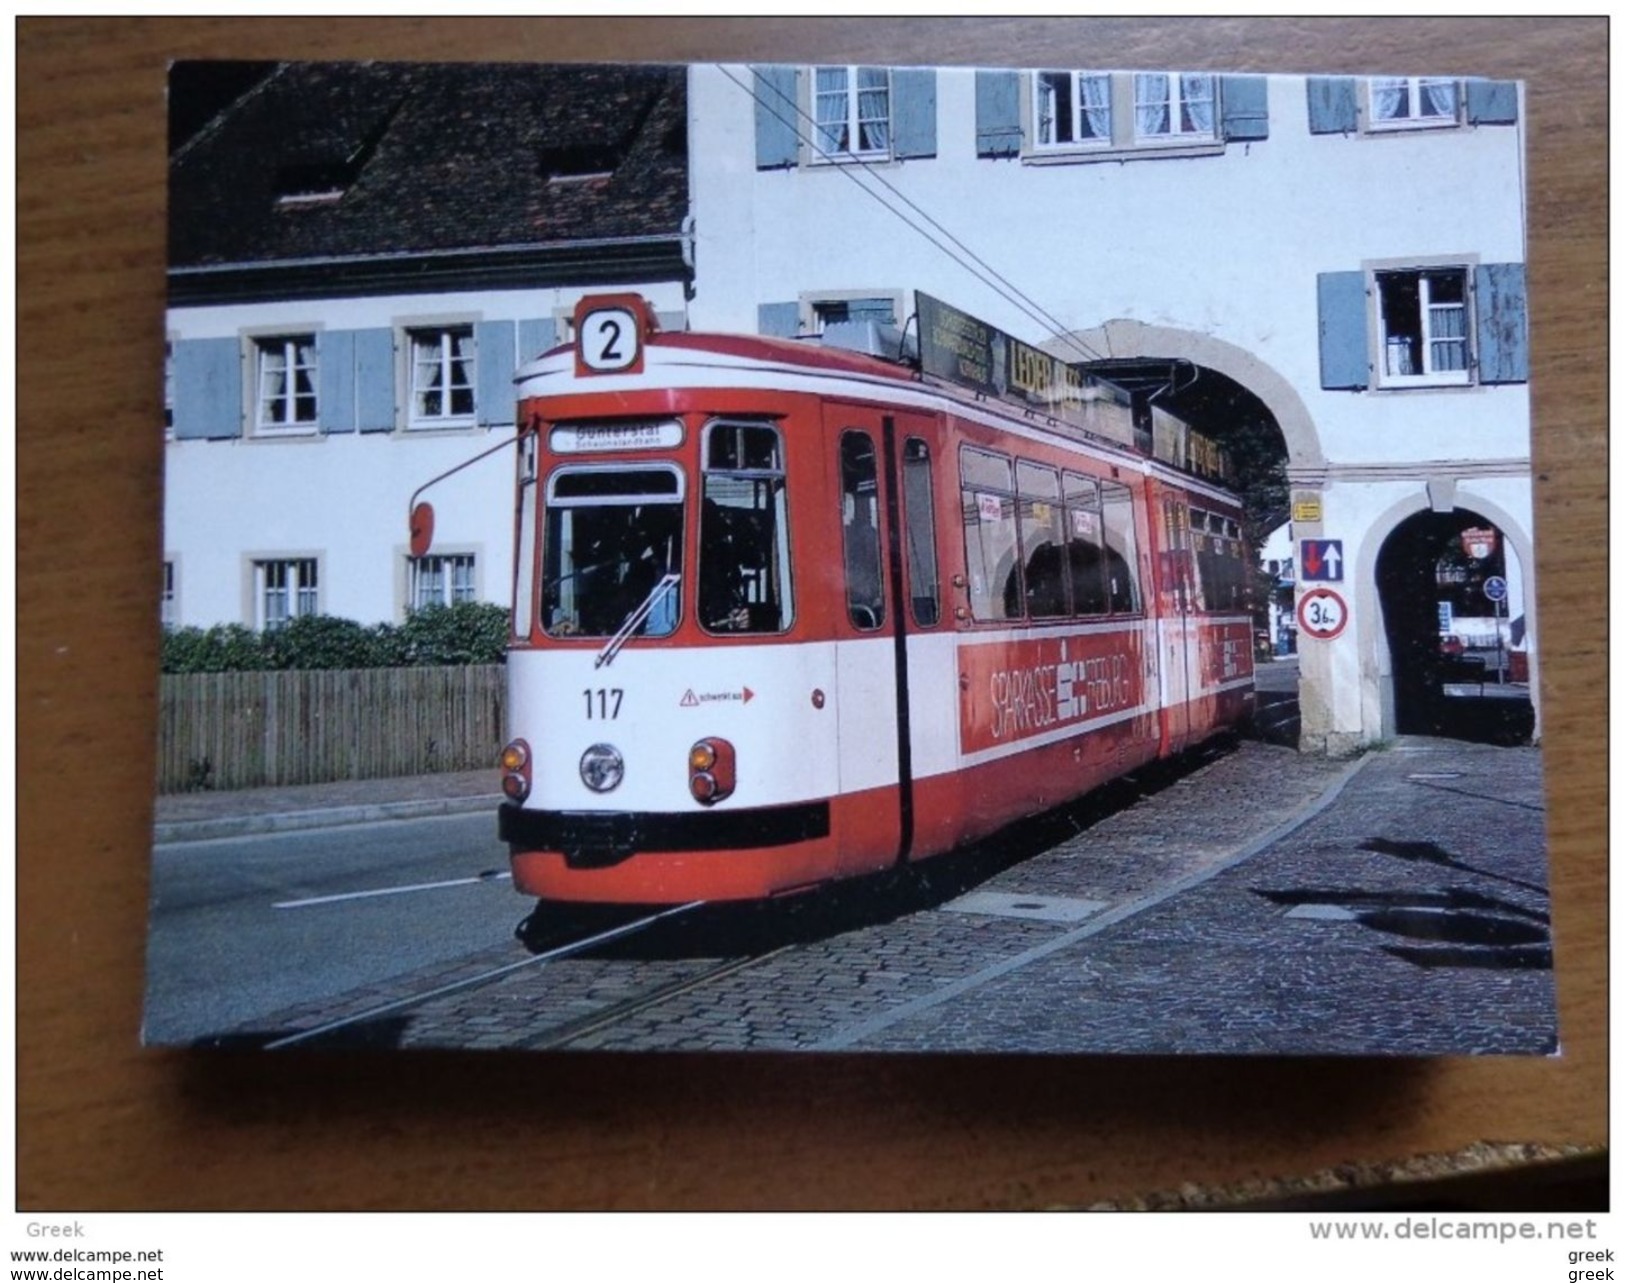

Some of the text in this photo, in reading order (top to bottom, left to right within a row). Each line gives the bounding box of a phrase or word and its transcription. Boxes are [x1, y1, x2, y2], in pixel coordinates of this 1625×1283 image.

[600, 320, 621, 360] 2
[584, 689, 624, 719] 117
[990, 664, 1056, 738] SPARKASSE
